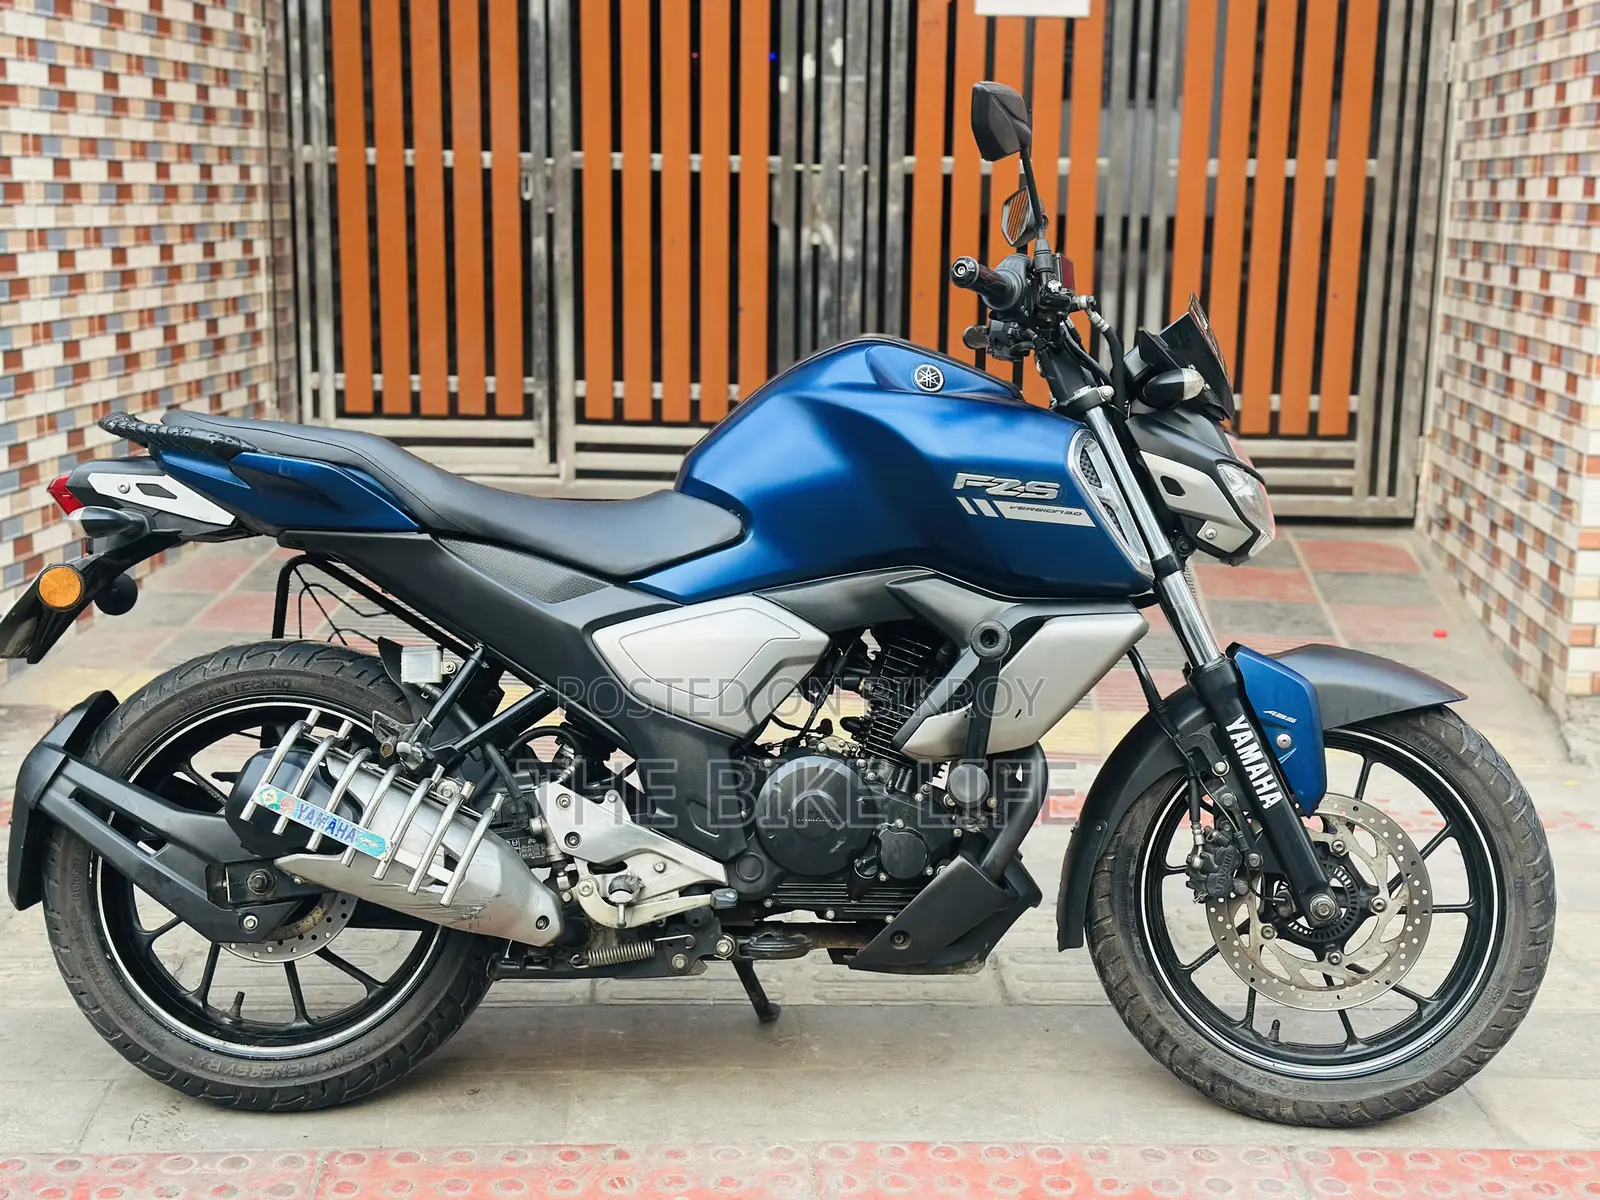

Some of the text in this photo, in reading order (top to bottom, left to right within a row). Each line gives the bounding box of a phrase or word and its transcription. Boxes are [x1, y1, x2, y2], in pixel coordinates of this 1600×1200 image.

[1009, 505, 1064, 515] VERSION
[1225, 714, 1283, 810] YAMAHA
[295, 803, 358, 846] YAMAHA
